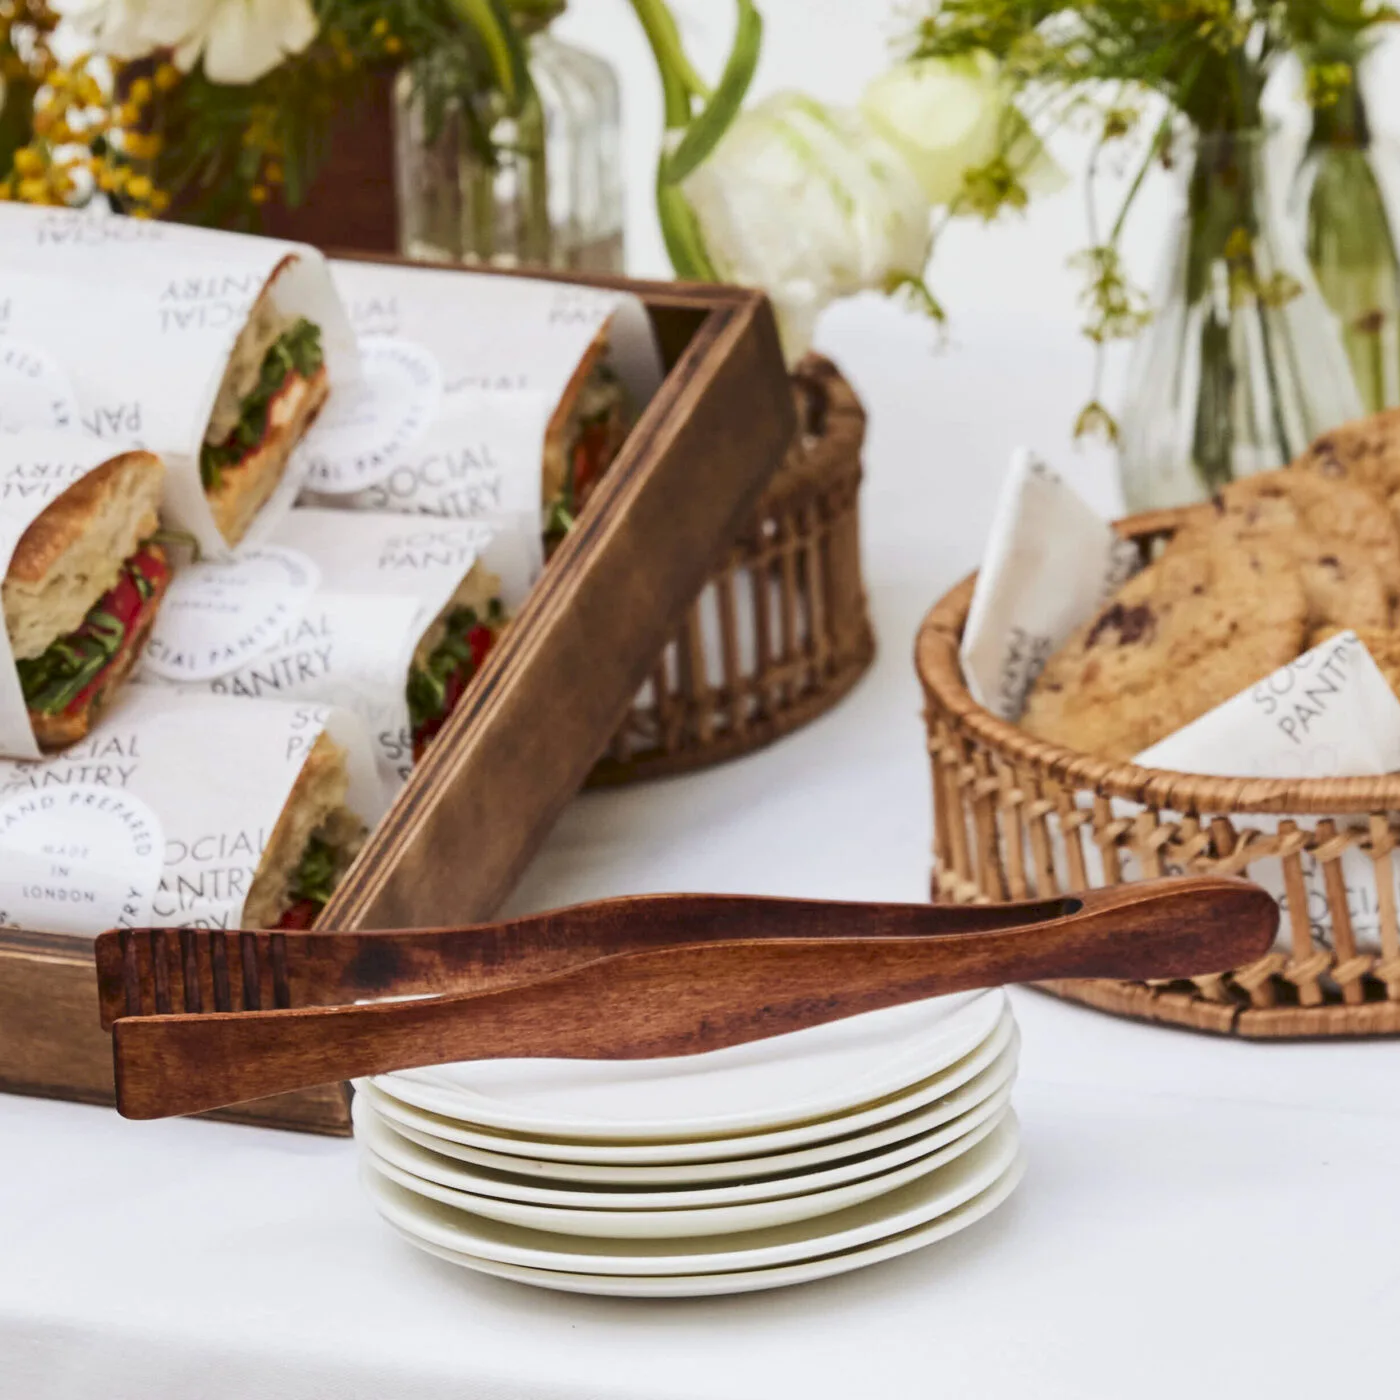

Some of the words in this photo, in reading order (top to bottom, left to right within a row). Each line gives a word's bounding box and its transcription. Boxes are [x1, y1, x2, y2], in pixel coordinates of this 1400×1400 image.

[160, 272, 264, 302] NTRY
[158, 303, 250, 334] CIAL
[262, 612, 334, 652] IAL
[62, 734, 141, 761] IAL
[22, 885, 96, 904] LONDON
[156, 866, 256, 901] NTR
